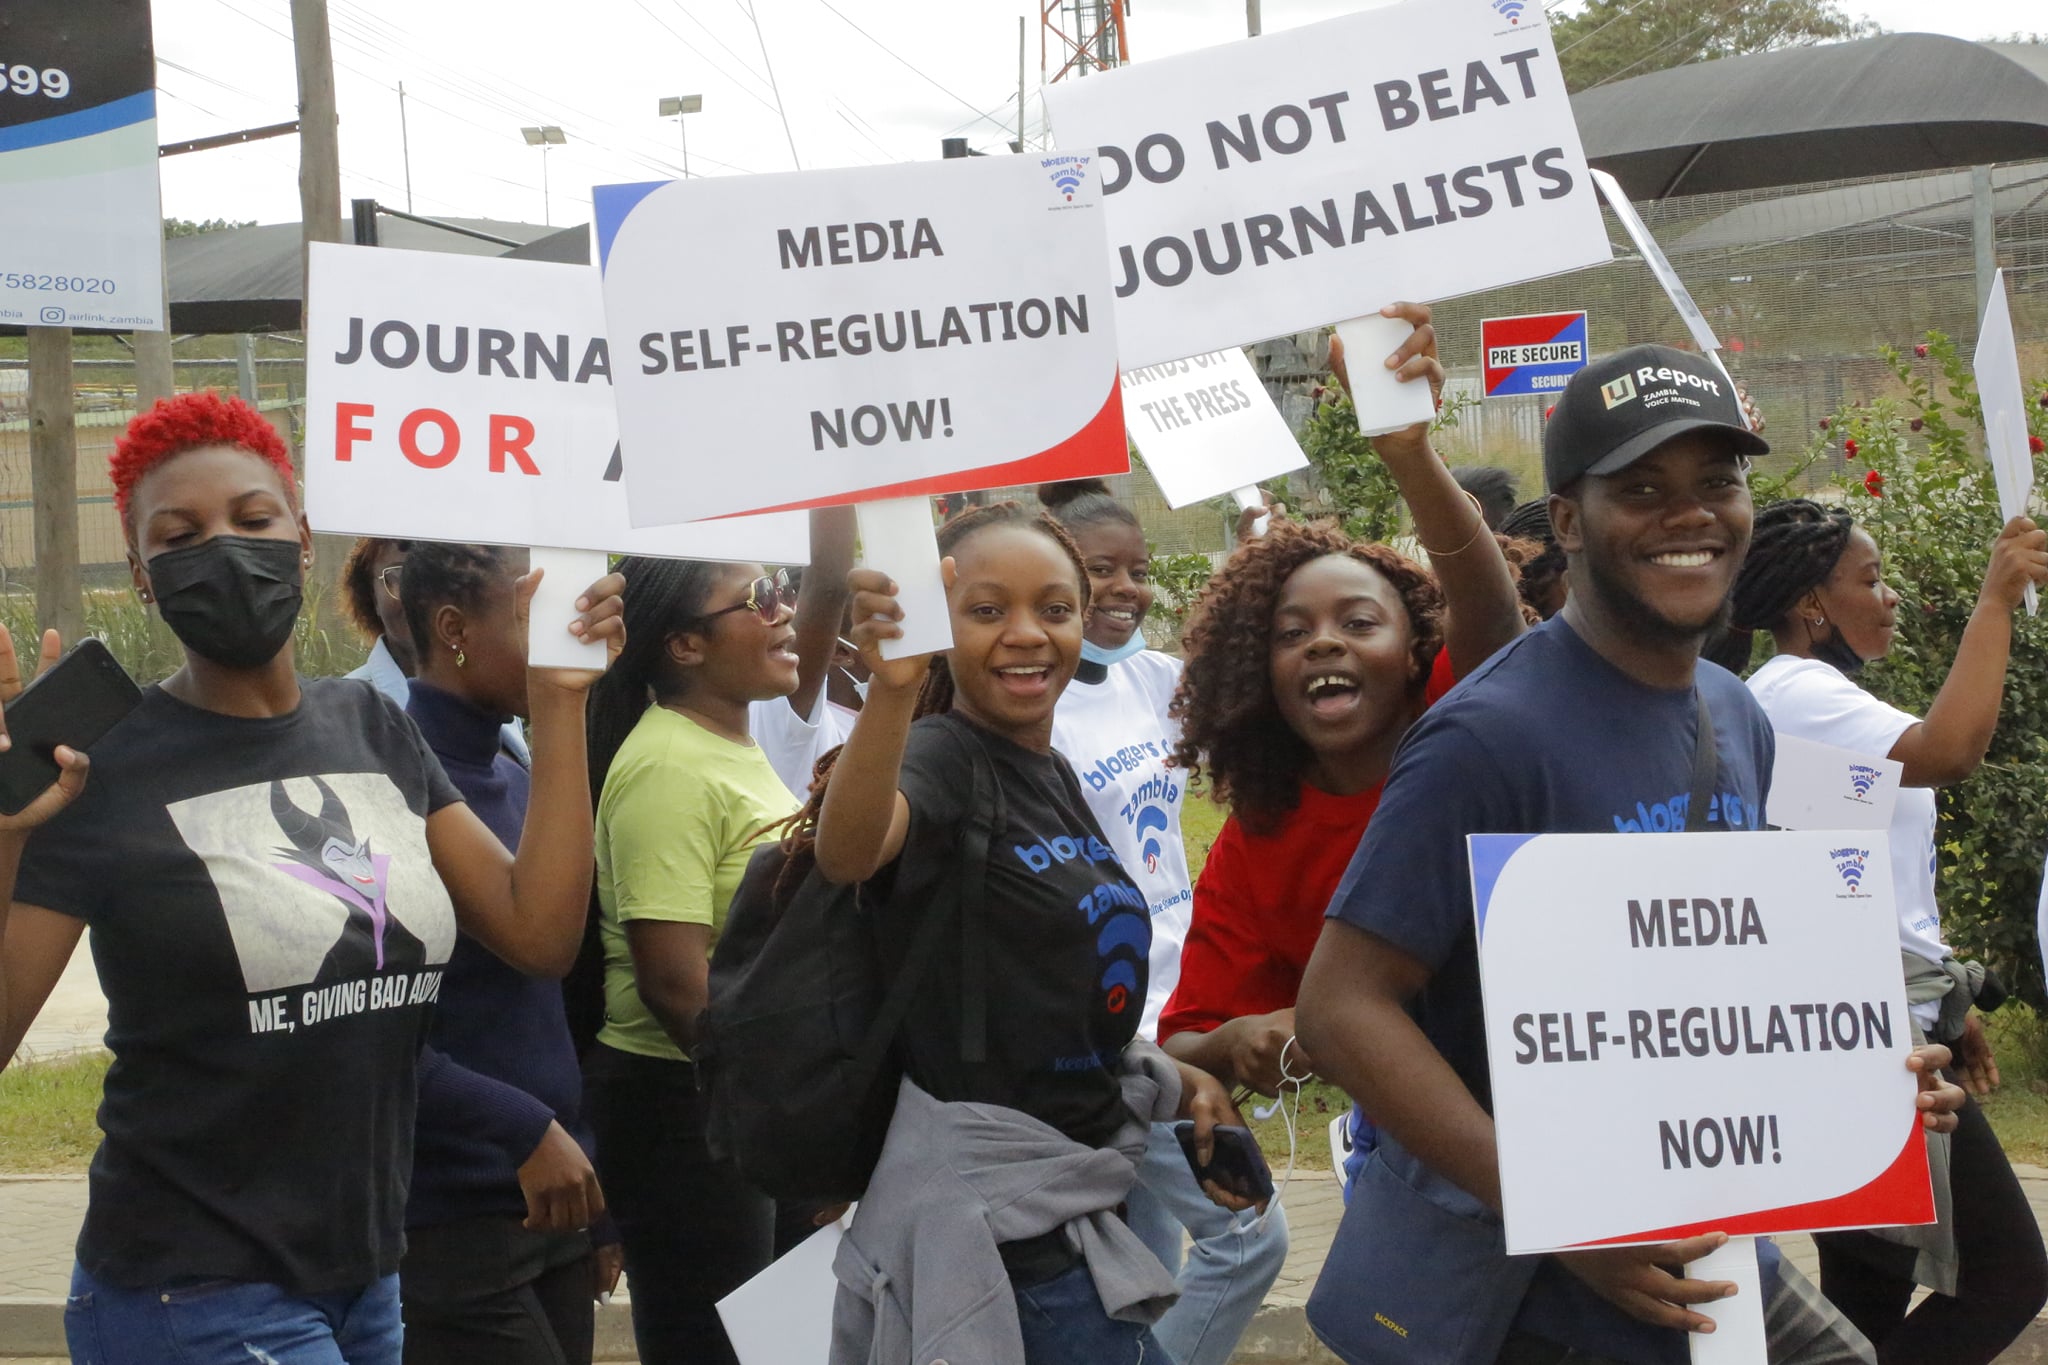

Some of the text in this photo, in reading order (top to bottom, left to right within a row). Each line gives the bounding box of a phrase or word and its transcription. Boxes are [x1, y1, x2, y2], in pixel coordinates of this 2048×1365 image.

[0, 63, 70, 98] 99
[1097, 48, 1539, 196] DO NOT BEAT
[777, 217, 944, 270] MEDIA
[1115, 147, 1574, 298] JOURNALISTS
[0, 273, 115, 295] 5828020
[335, 317, 613, 386] JOURNA
[639, 294, 1090, 375] SELF-REGULATION
[1491, 344, 1579, 365] PRE SECURE
[1139, 379, 1252, 433] THE PRESS
[1636, 366, 1721, 397] Report
[1642, 388, 1679, 402] ZAMBIA
[1644, 396, 1701, 409] VOICE MATTERS
[335, 401, 541, 476] FOR
[810, 397, 954, 451] NOW!
[1120, 772, 1178, 825] zambia
[1627, 897, 1768, 948] MEDIA
[249, 996, 295, 1034] ME,
[302, 979, 366, 1026] GIVING
[370, 974, 408, 1011] BAD
[1512, 1001, 1893, 1065] SELF-REGULATION
[1658, 1114, 1782, 1170] NOW!
[1374, 1311, 1409, 1339] BACKPACK
